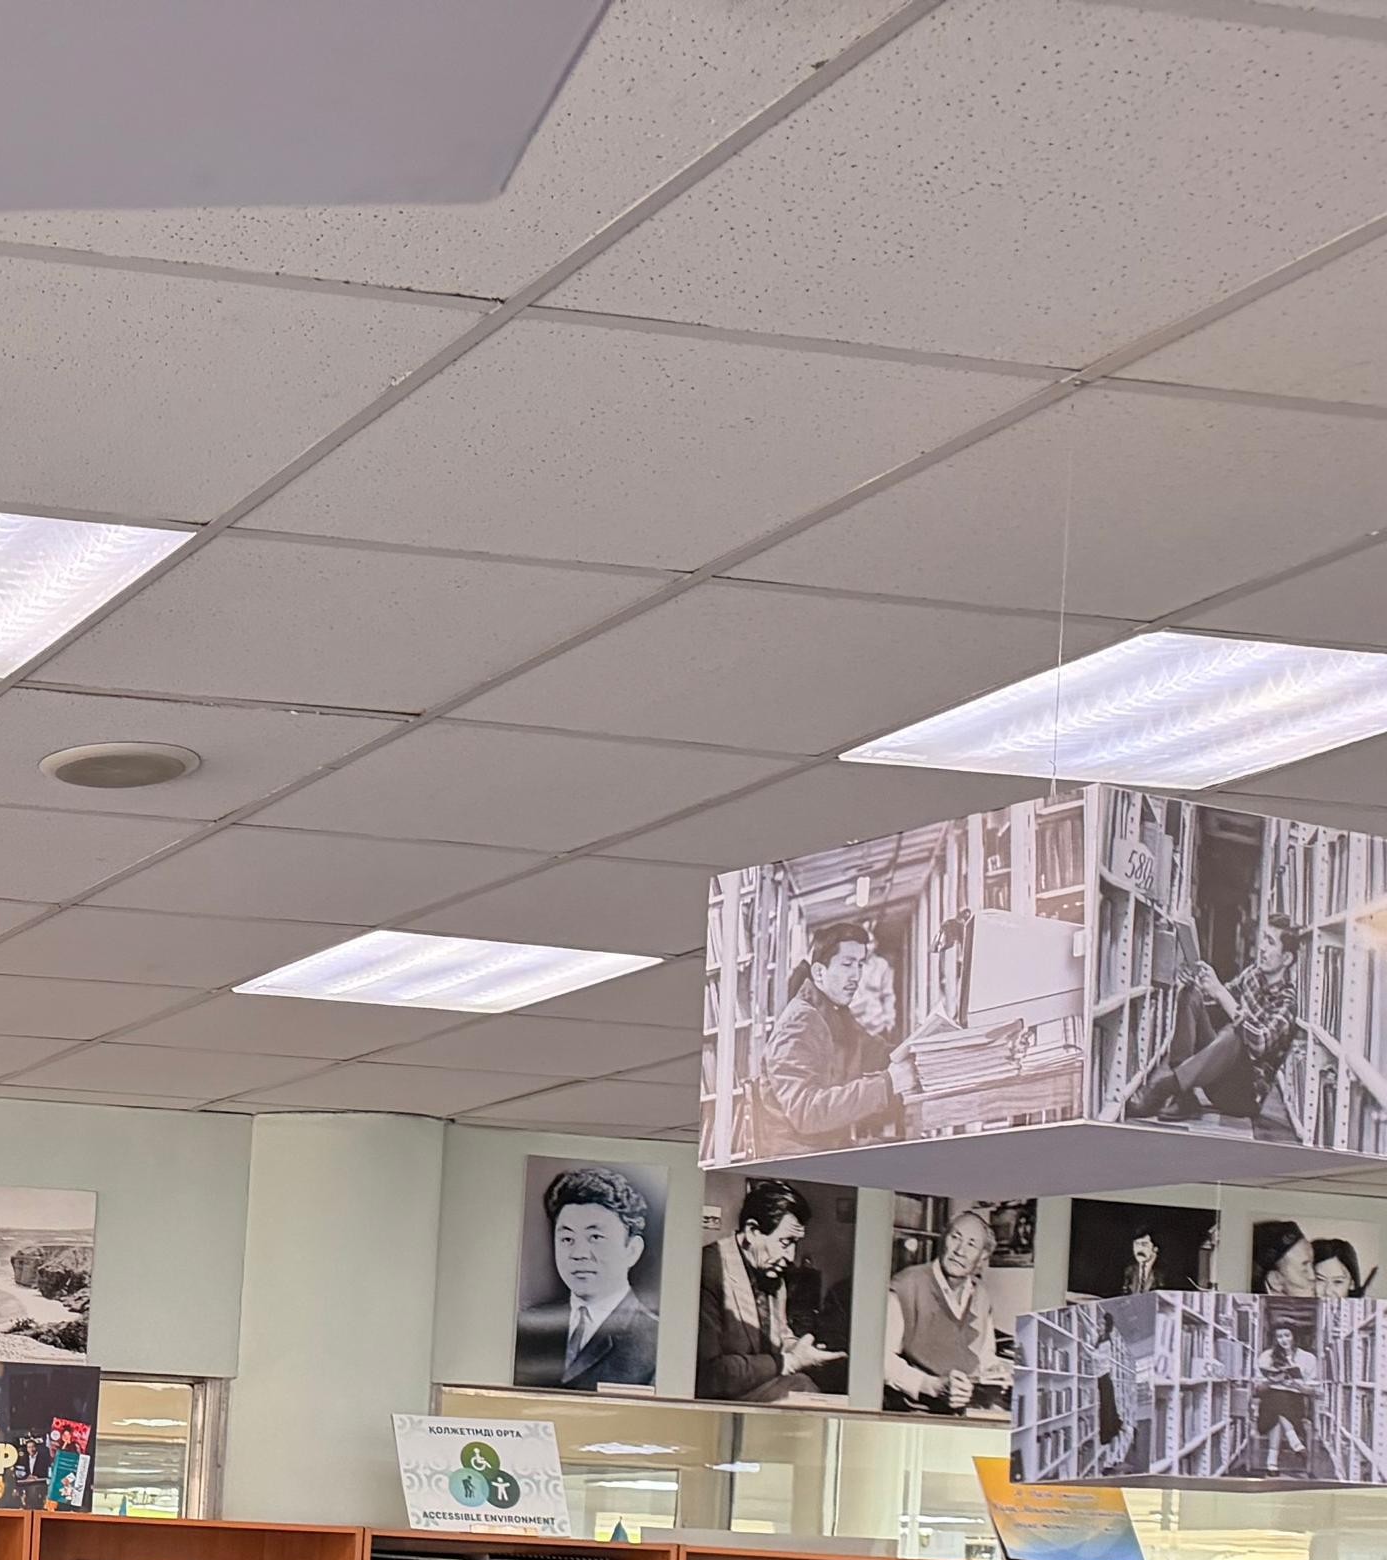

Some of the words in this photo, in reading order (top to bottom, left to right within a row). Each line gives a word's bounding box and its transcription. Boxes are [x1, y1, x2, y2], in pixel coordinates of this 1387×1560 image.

[428, 1426, 494, 1439] ҚОЛЖЕТІМДІ
[496, 1429, 523, 1439] ОРТА
[422, 1511, 482, 1522] ACCESSIBLE
[484, 1514, 555, 1525] ENVIRONMENT
